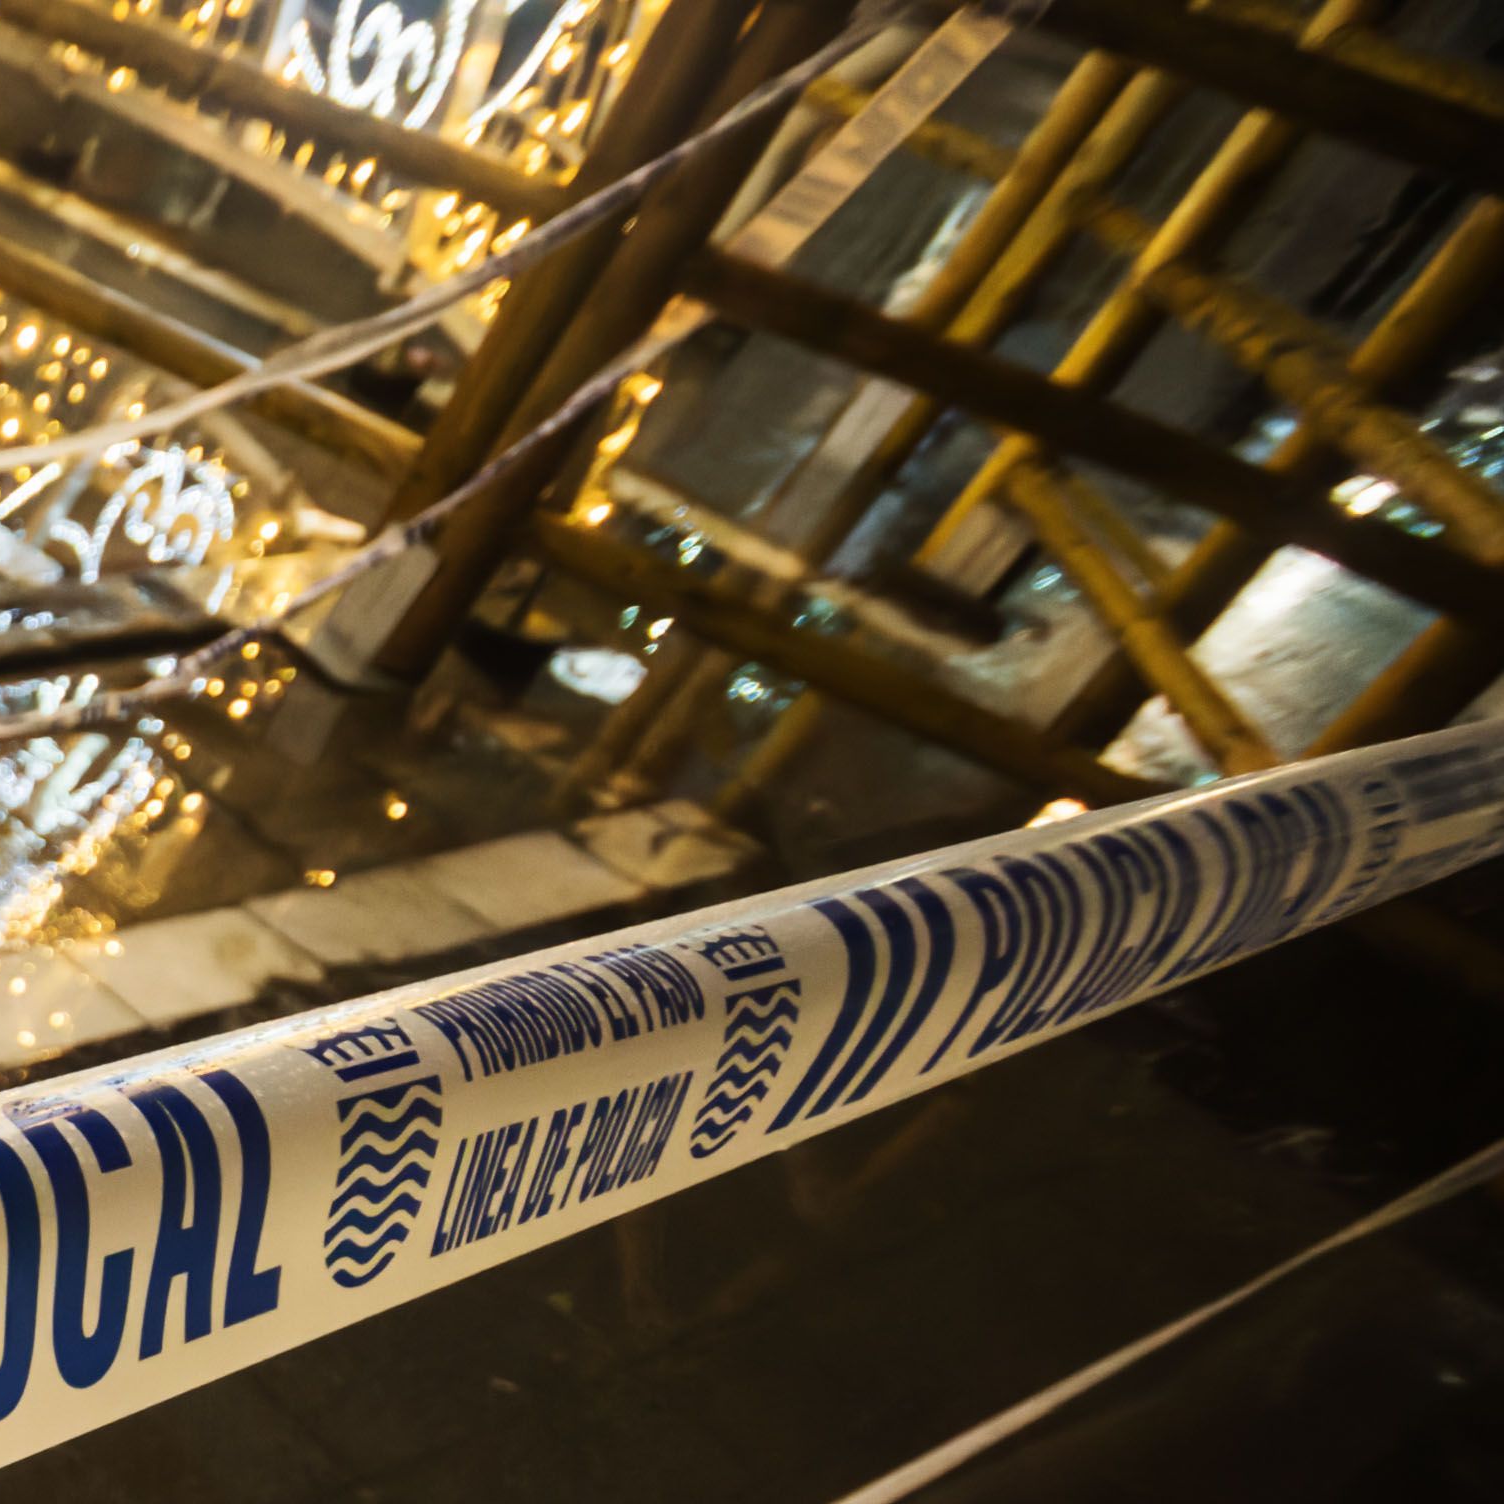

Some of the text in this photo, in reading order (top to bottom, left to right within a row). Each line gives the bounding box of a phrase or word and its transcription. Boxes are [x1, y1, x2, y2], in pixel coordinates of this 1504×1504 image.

[411, 943, 706, 1082] PROHIBIDO EL PASO
[919, 818, 1200, 1075] POLICIA
[430, 1070, 695, 1258] LINEA DE POLICIA
